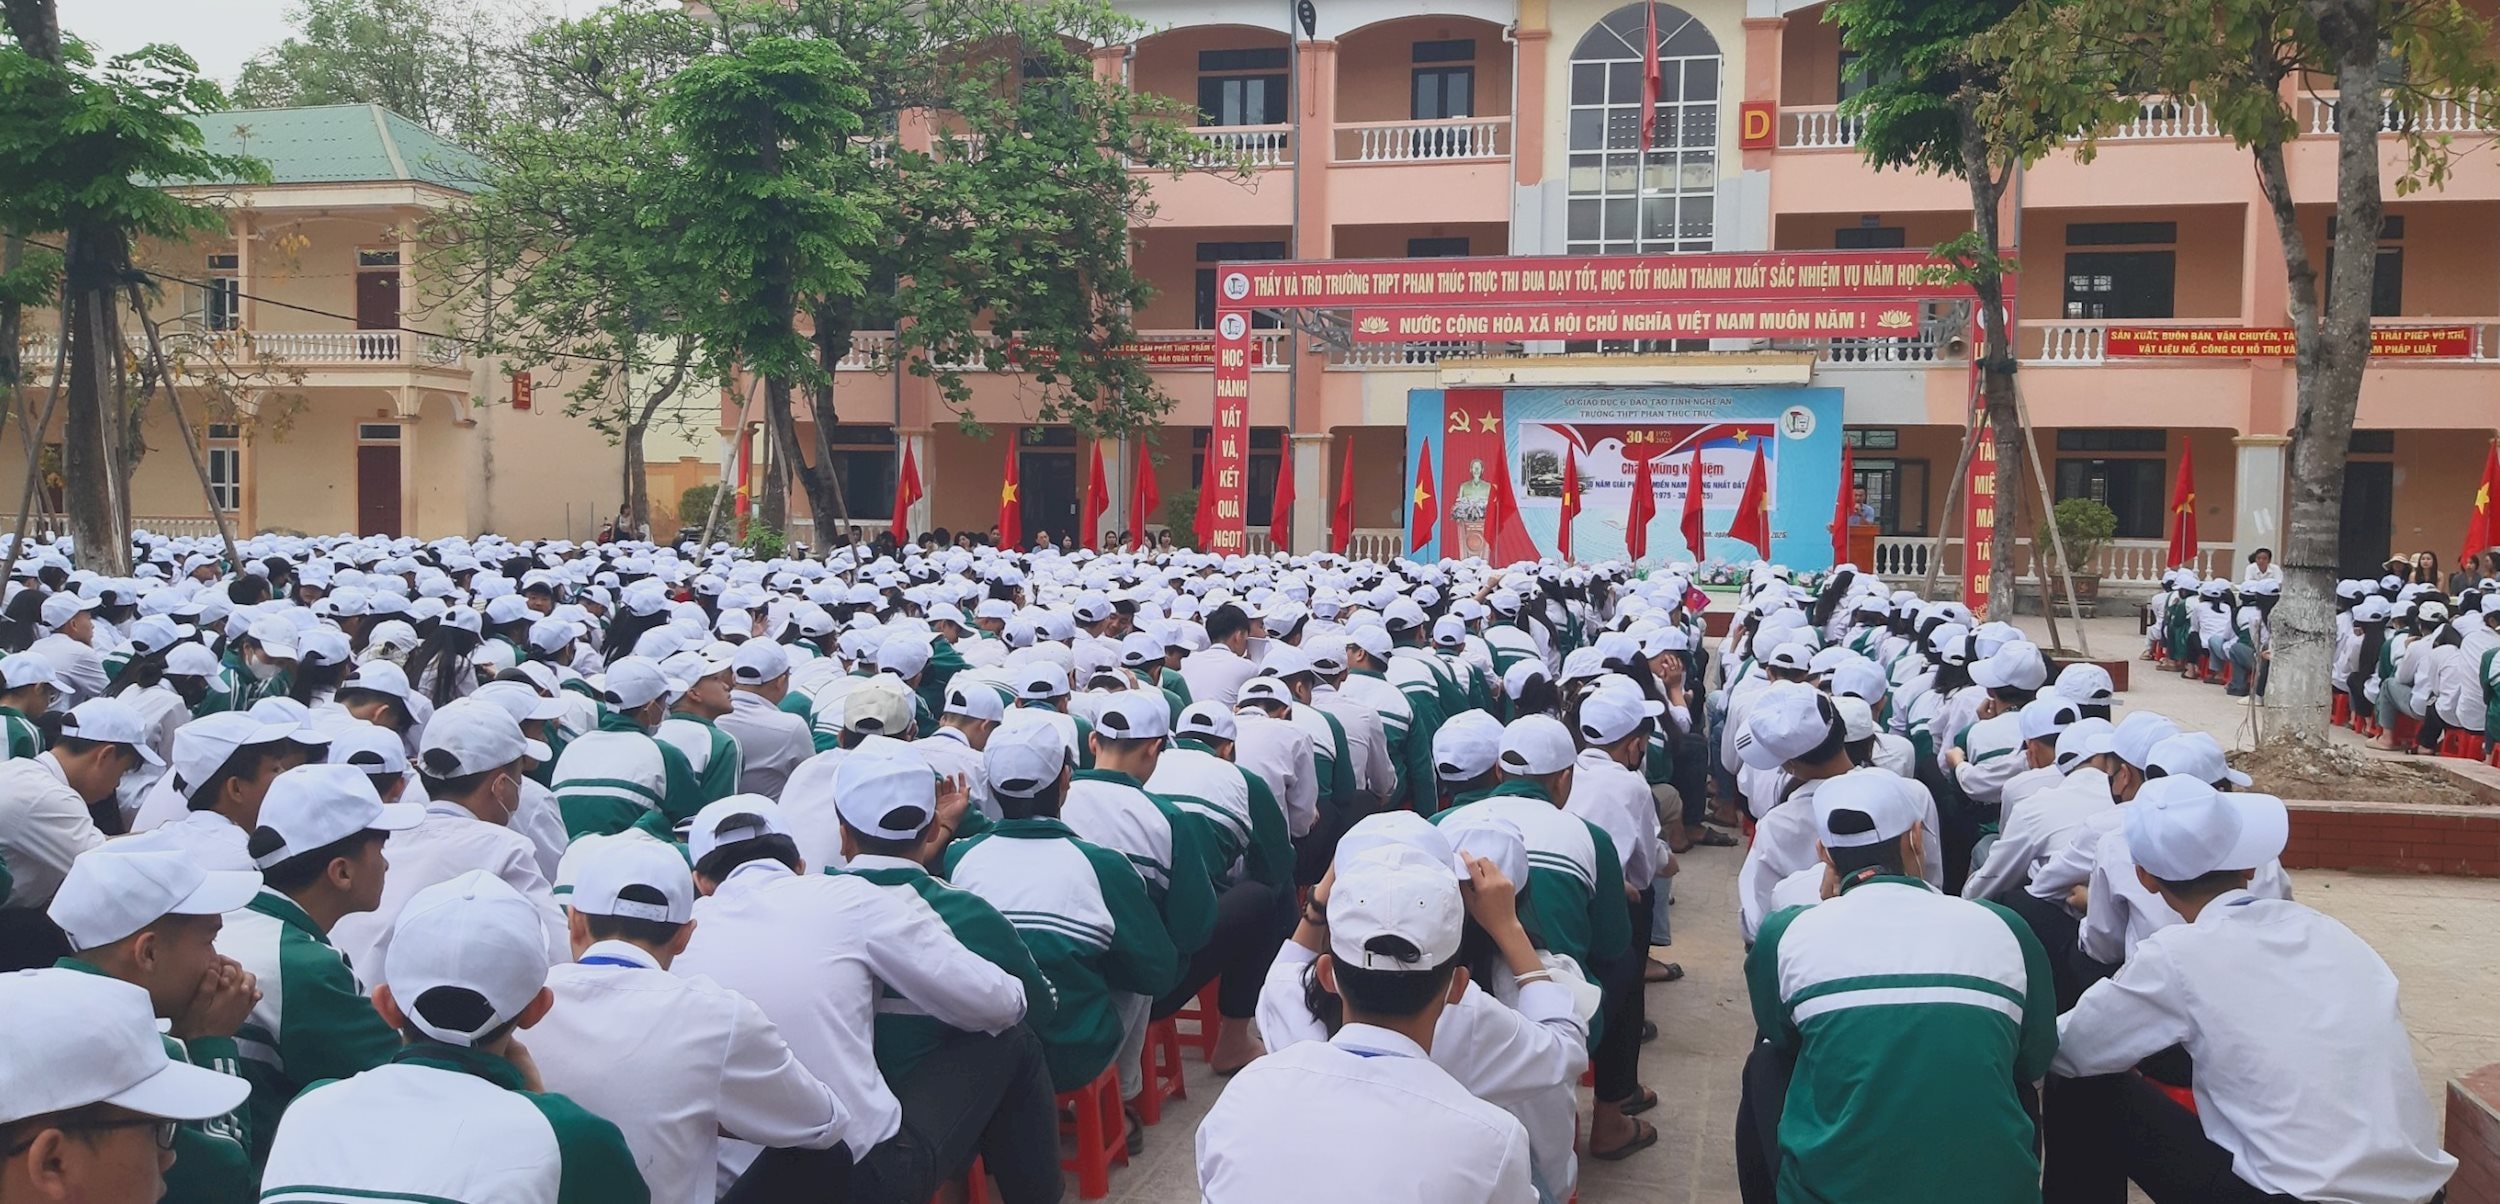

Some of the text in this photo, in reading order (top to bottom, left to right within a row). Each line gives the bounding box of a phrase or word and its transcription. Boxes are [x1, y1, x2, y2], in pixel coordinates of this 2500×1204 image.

[1745, 110, 1770, 140] D
[1254, 270, 1281, 297] THẦY
[1284, 272, 1298, 296] VÀ
[1302, 270, 1322, 296] TRÒ
[1326, 269, 1369, 295] TRƯỜNG
[1373, 273, 1400, 294] THPT
[1403, 272, 1434, 294] PHAN
[1438, 268, 1465, 293] THÚC
[1468, 269, 1498, 297] TRỰC
[1501, 271, 1519, 292] THI
[1522, 270, 1545, 292] ĐUA
[1549, 270, 1572, 296] DẠY
[1575, 262, 1597, 294] TỐT,
[1601, 269, 1625, 295] HỌC
[1629, 262, 1650, 290] TỐT
[1654, 263, 1687, 290] HOÀN
[1691, 263, 1731, 289] THÀNH
[1734, 259, 1767, 289] XUẤT
[1770, 258, 1795, 288] SẮC
[1798, 261, 1840, 292] NHIỆM
[1844, 265, 1860, 292] VỤ
[1864, 260, 1894, 286] NĂM
[1400, 308, 1866, 337] NƯỚC CỘNG HÒA XÃ HỘI CHỦ NGHĨA VIỆT NAM MUÔN NĂM !
[2111, 329, 2131, 340] SẢN
[2162, 330, 2188, 340] BUÔN
[2217, 330, 2237, 342] VẬN
[1222, 348, 1244, 371] HỌC
[2139, 343, 2156, 355] VẬT
[2159, 344, 2179, 355] LIỆU
[2201, 344, 2228, 354] CÔNG
[2231, 345, 2244, 355] CỤ
[2263, 345, 2281, 355] TRỢ
[2385, 343, 2411, 354] PHÁP
[2414, 343, 2437, 355] LUẬT
[1217, 376, 1247, 398] HÀNH
[1221, 404, 1241, 428] VẤT
[1222, 434, 1239, 459] VẢ,
[1219, 467, 1240, 488] KẾT
[1702, 462, 1723, 477] iệm
[1217, 495, 1239, 519] QUẢ
[1213, 530, 1243, 553] NGỌT
